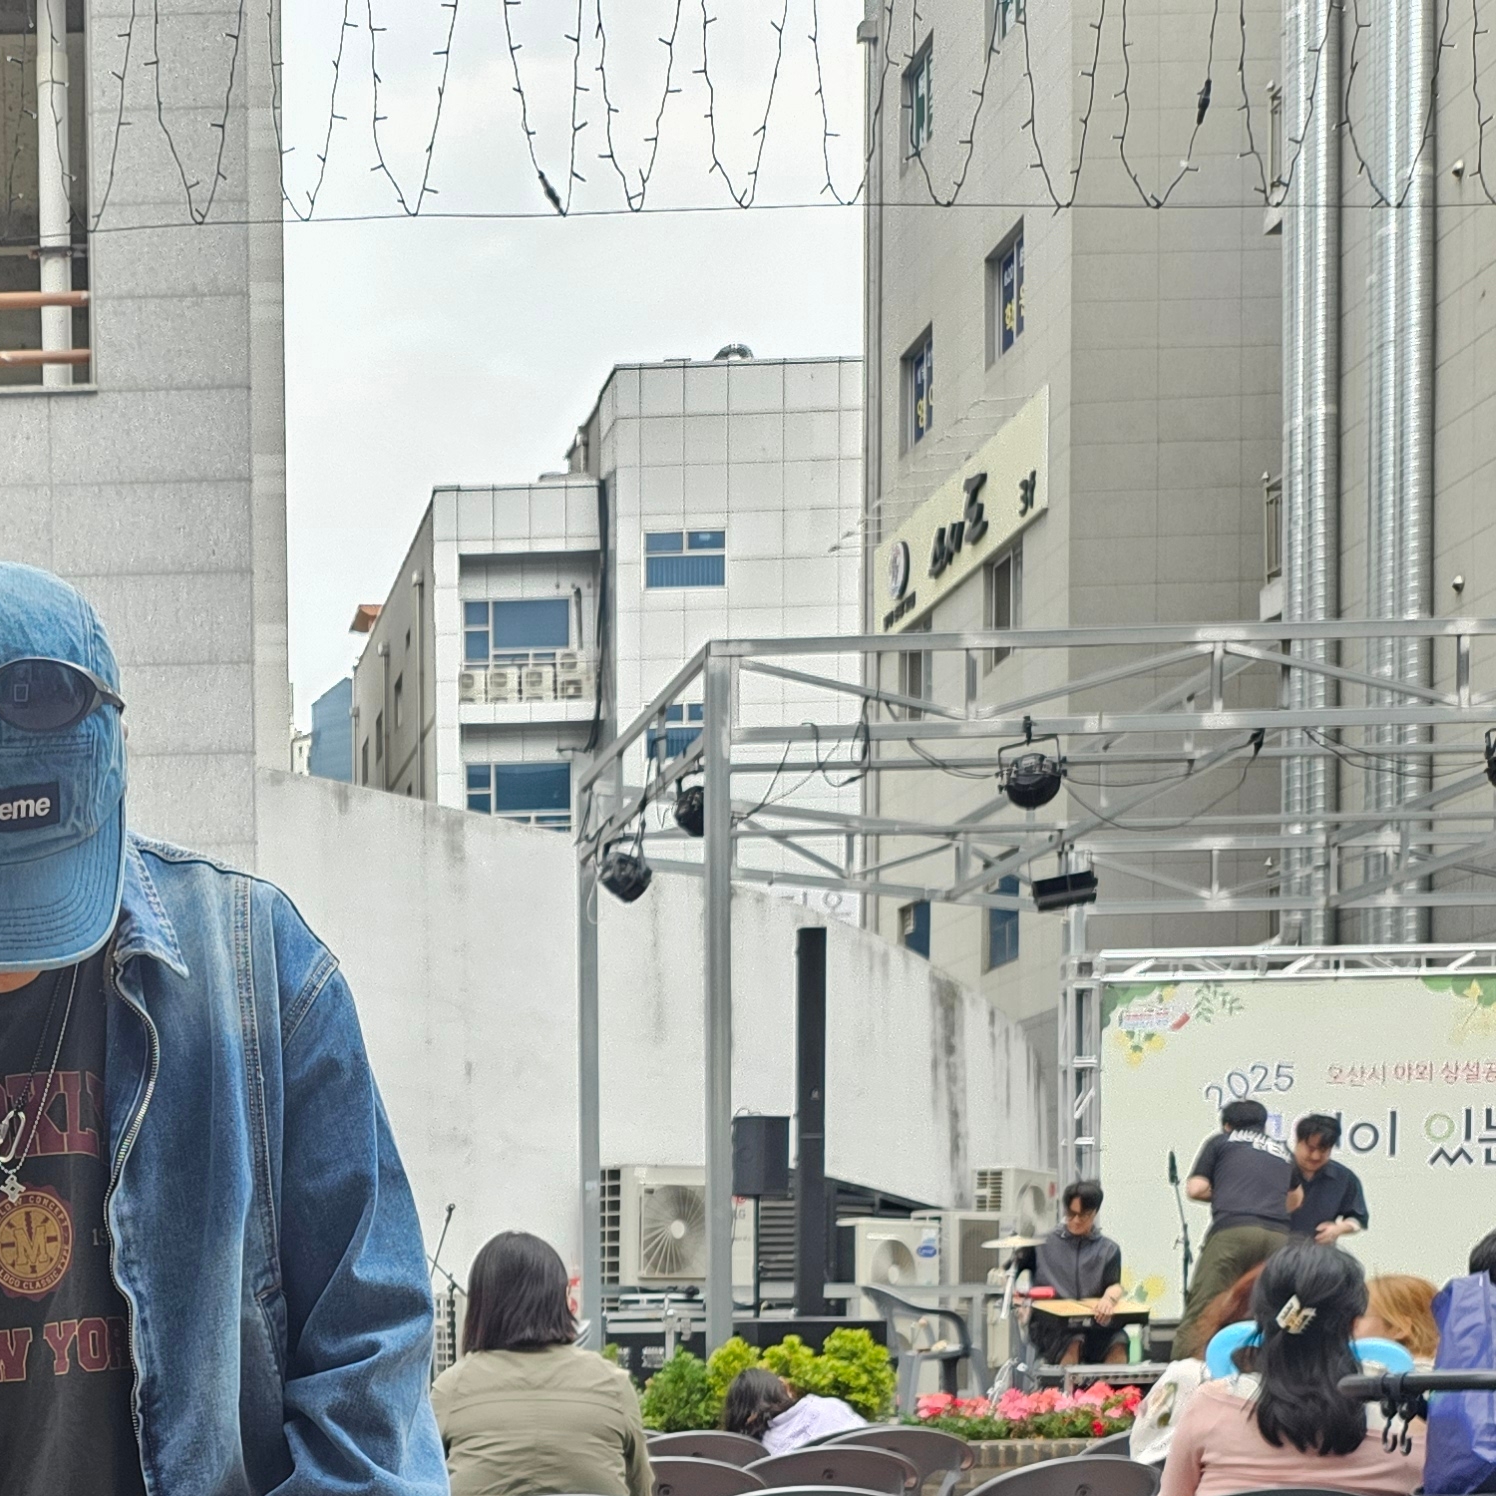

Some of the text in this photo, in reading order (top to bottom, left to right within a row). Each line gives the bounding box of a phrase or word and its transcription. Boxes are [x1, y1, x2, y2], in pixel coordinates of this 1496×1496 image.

[1205, 1064, 1295, 1110] 2025
[1326, 1061, 1386, 1087] 오산시
[1394, 1060, 1434, 1083] 야외
[28, 1195, 69, 1227] CONCEPT
[13, 1225, 48, 1266] M
[0, 1268, 21, 1288] LOGO
[22, 1269, 61, 1290] CLASSIC
